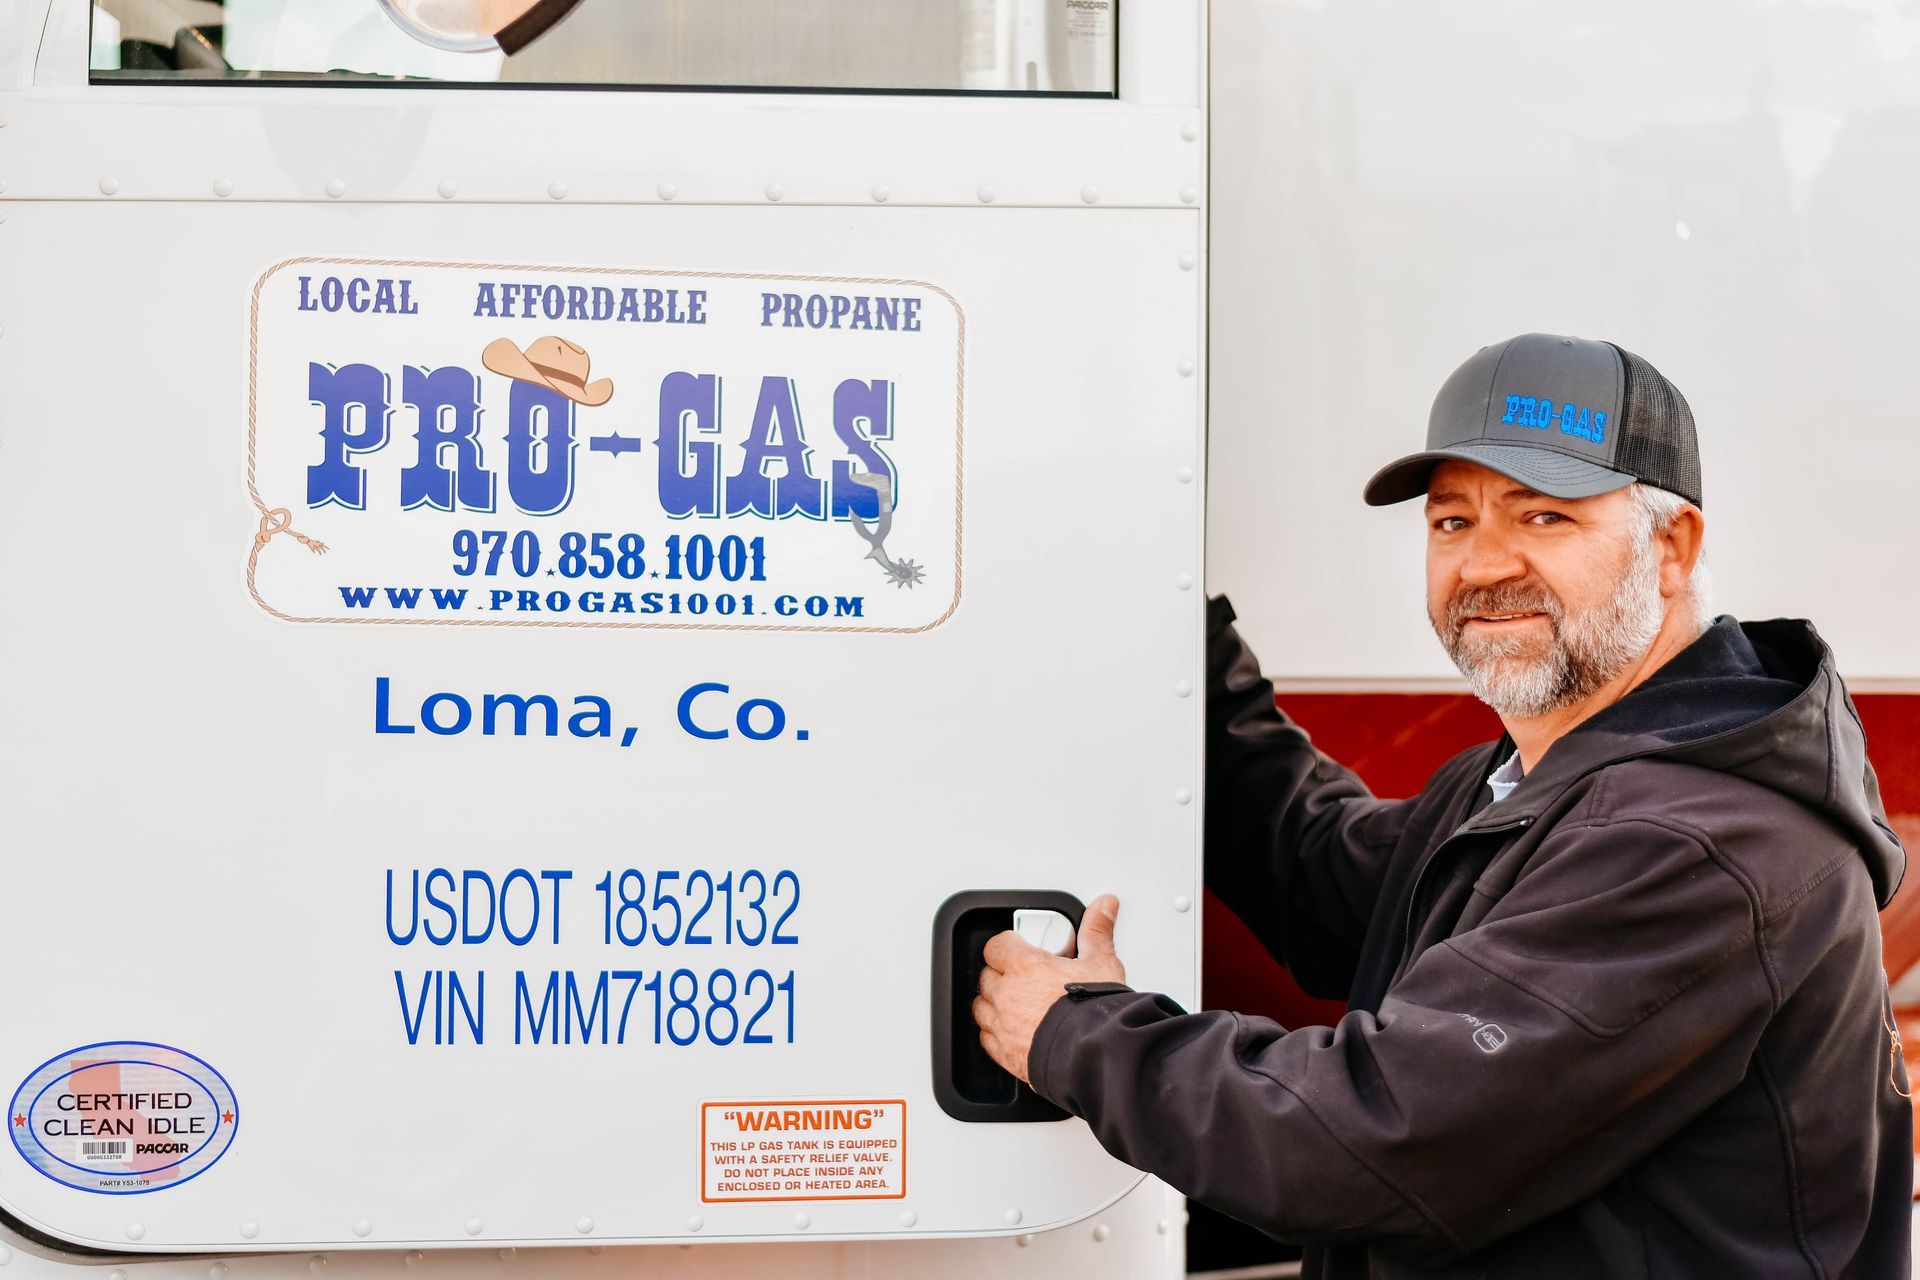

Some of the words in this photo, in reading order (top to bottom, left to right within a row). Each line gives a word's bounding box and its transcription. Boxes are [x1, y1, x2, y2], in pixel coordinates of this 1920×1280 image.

[298, 276, 419, 315] LOCAL
[474, 282, 708, 324] AFFORDABLE
[760, 292, 922, 332] PROPANE
[1502, 394, 1608, 444] PRO-GAS
[305, 360, 899, 523] PRO-GAS
[375, 676, 638, 747] Loma,
[677, 682, 809, 741] Co.
[386, 867, 573, 947] USDOT
[595, 868, 800, 947] 1852132
[394, 969, 485, 1045] VIN
[514, 968, 795, 1046] MM718821
[57, 1093, 192, 1111] CERTIFIED
[44, 1118, 134, 1136] CLEAN
[147, 1117, 205, 1134] IDLE
[136, 1143, 189, 1154] PACCAR
[710, 1142, 737, 1151] THIS
[741, 1141, 755, 1151] LP
[759, 1141, 783, 1150] GAS
[787, 1141, 819, 1149] TANK
[824, 1140, 834, 1149] IS
[839, 1139, 897, 1149] EQUIPPED
[714, 1155, 745, 1165] WITH
[749, 1155, 757, 1164] A
[761, 1154, 805, 1164] SAFETY
[809, 1154, 848, 1163] RELIEF
[853, 1153, 893, 1162] VALVE.
[724, 1169, 740, 1178] DO
[745, 1168, 769, 1178] NOT
[773, 1168, 810, 1177] PLACE
[815, 1167, 854, 1176] INSIDE
[859, 1166, 884, 1175] ANY
[717, 1182, 780, 1192] ENCLOSED
[785, 1181, 801, 1190] OR
[805, 1181, 850, 1190] HEATED
[855, 1180, 890, 1189] AREA.
